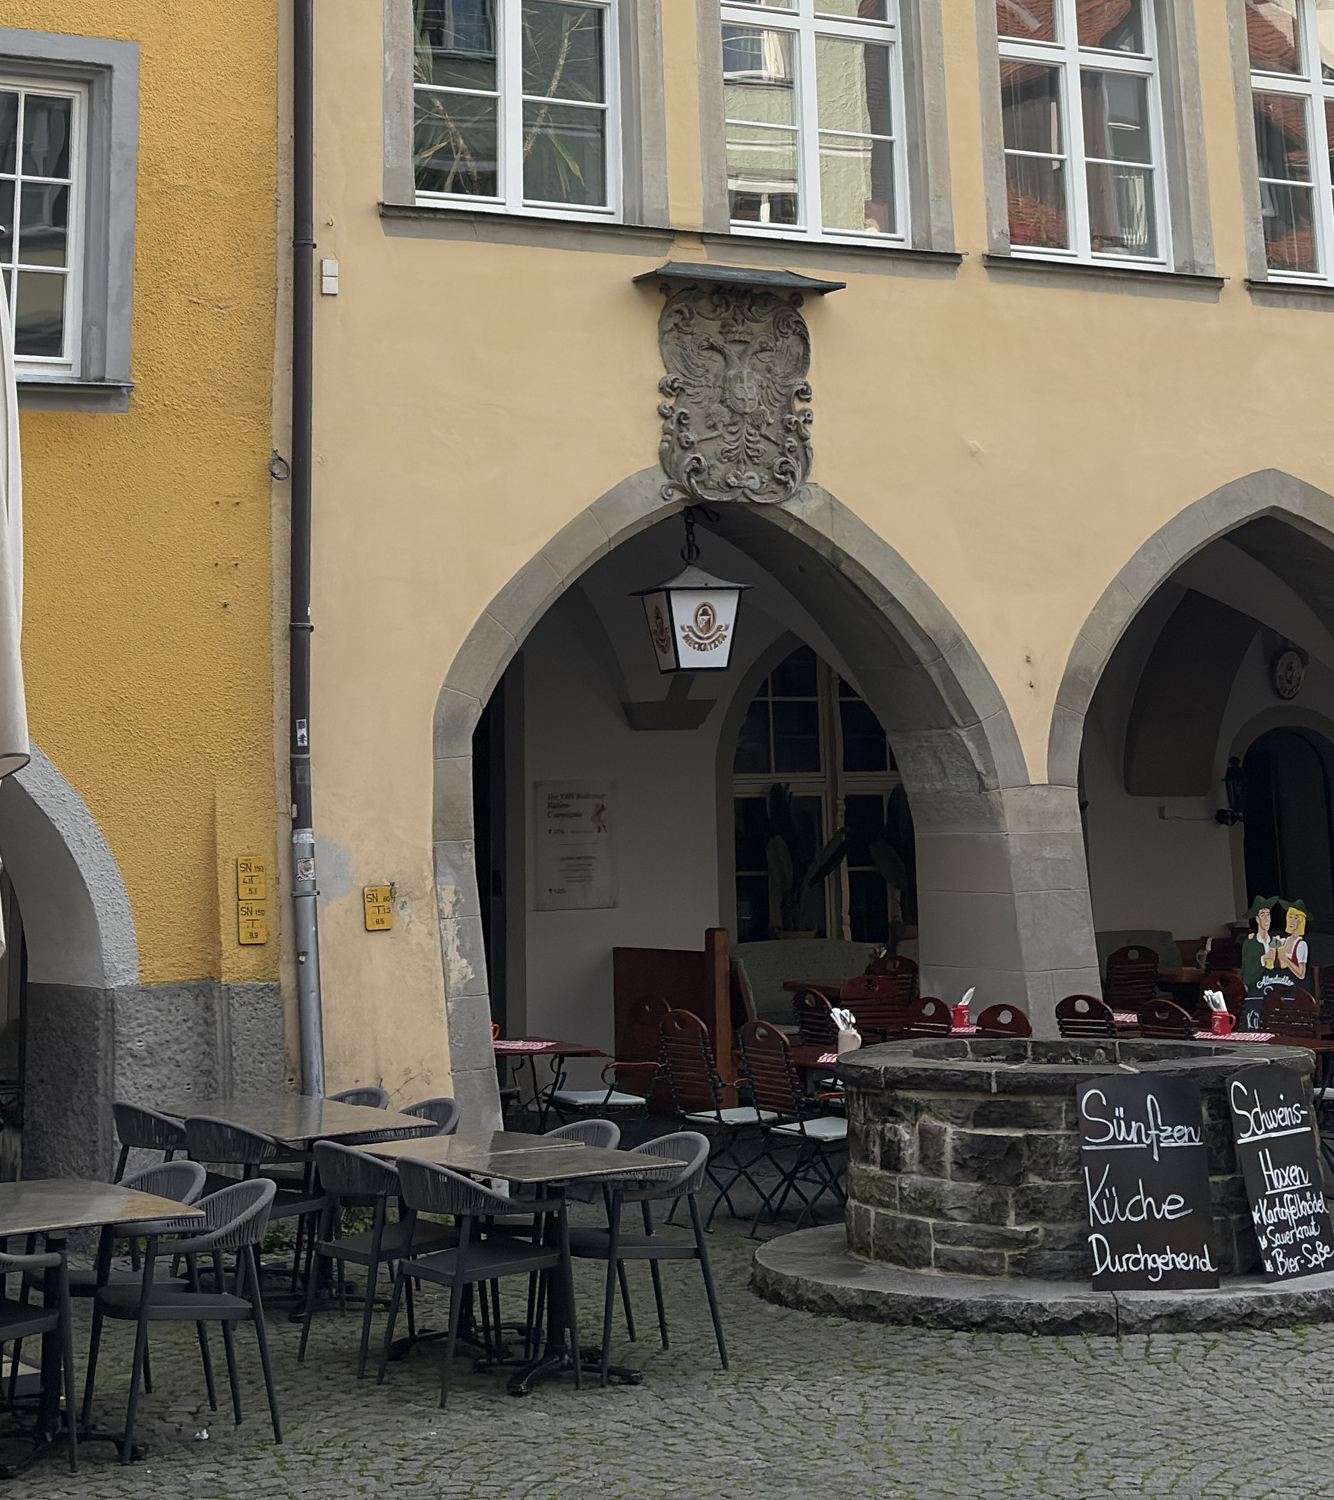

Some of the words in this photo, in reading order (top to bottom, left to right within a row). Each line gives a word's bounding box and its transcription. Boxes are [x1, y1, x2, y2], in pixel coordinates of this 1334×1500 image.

[681, 633, 728, 652] MECKATZER
[239, 862, 252, 873] SN
[240, 906, 253, 916] SN
[366, 893, 378, 903] SN
[1081, 1088, 1201, 1162] Sünfzen
[1230, 1081, 1309, 1139] Schweins-
[1258, 1148, 1310, 1192] Haxen
[1084, 1164, 1194, 1227] Küche
[1258, 1191, 1330, 1227] Kartoffelknödel
[1266, 1216, 1321, 1247] Sauerkraut
[1087, 1233, 1219, 1283] Durchgehend
[1271, 1240, 1334, 1276] Bier-Soße
